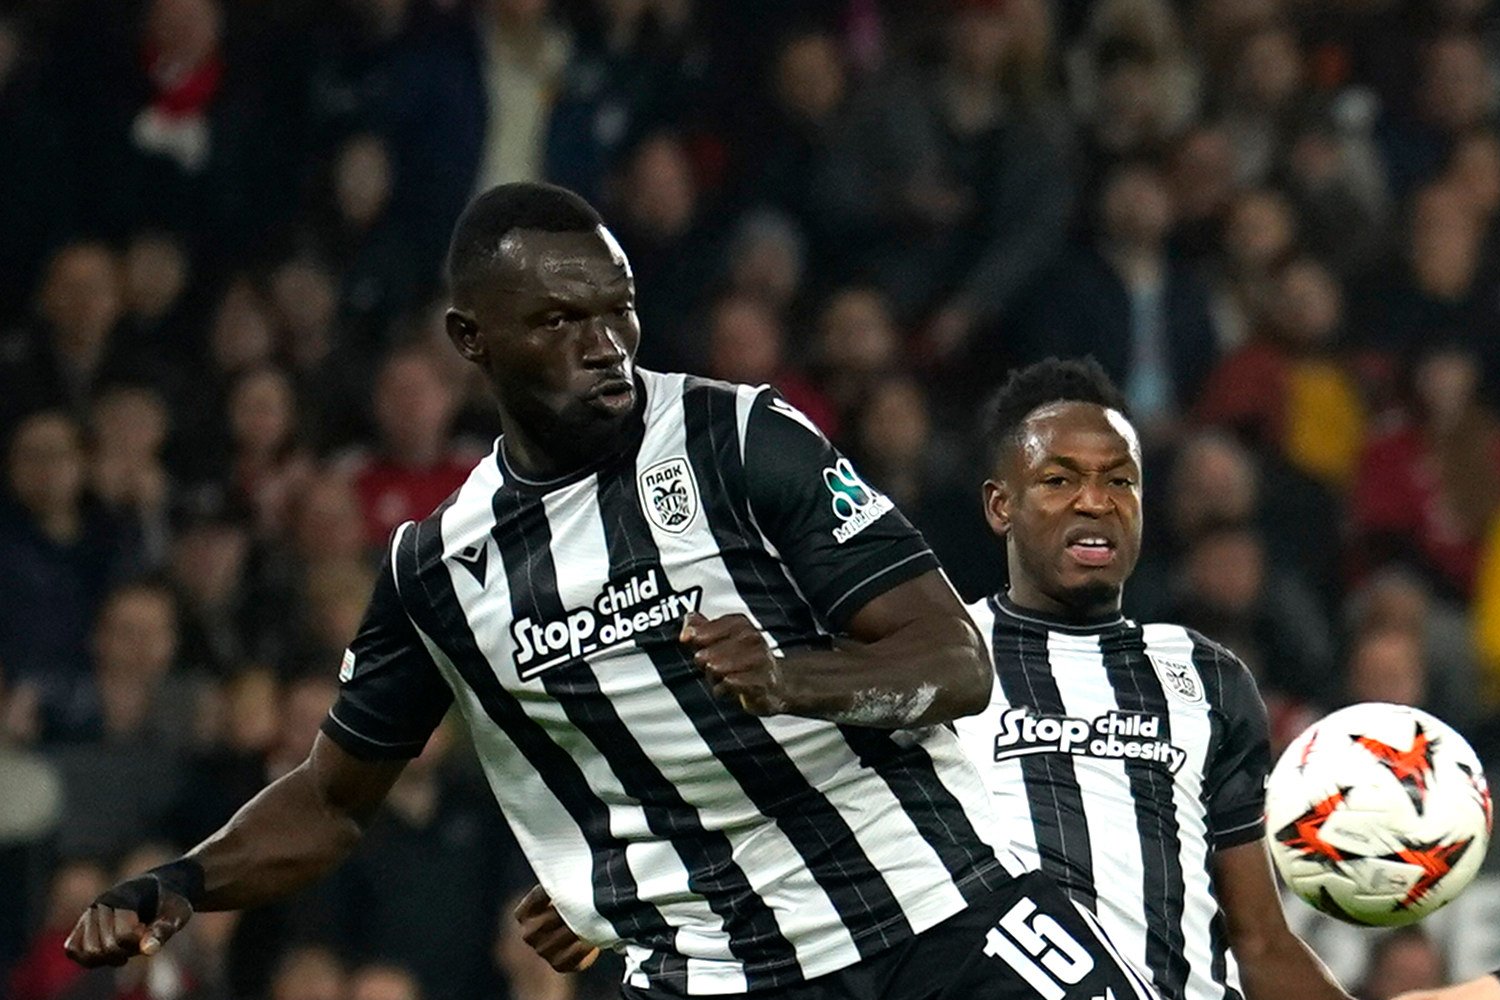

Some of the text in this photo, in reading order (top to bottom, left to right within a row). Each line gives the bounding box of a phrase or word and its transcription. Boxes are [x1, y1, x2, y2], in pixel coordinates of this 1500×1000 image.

[514, 569, 659, 664] Stop child
[599, 589, 699, 645] obesity
[997, 708, 1159, 753] Stop child
[1089, 734, 1185, 773] obesity
